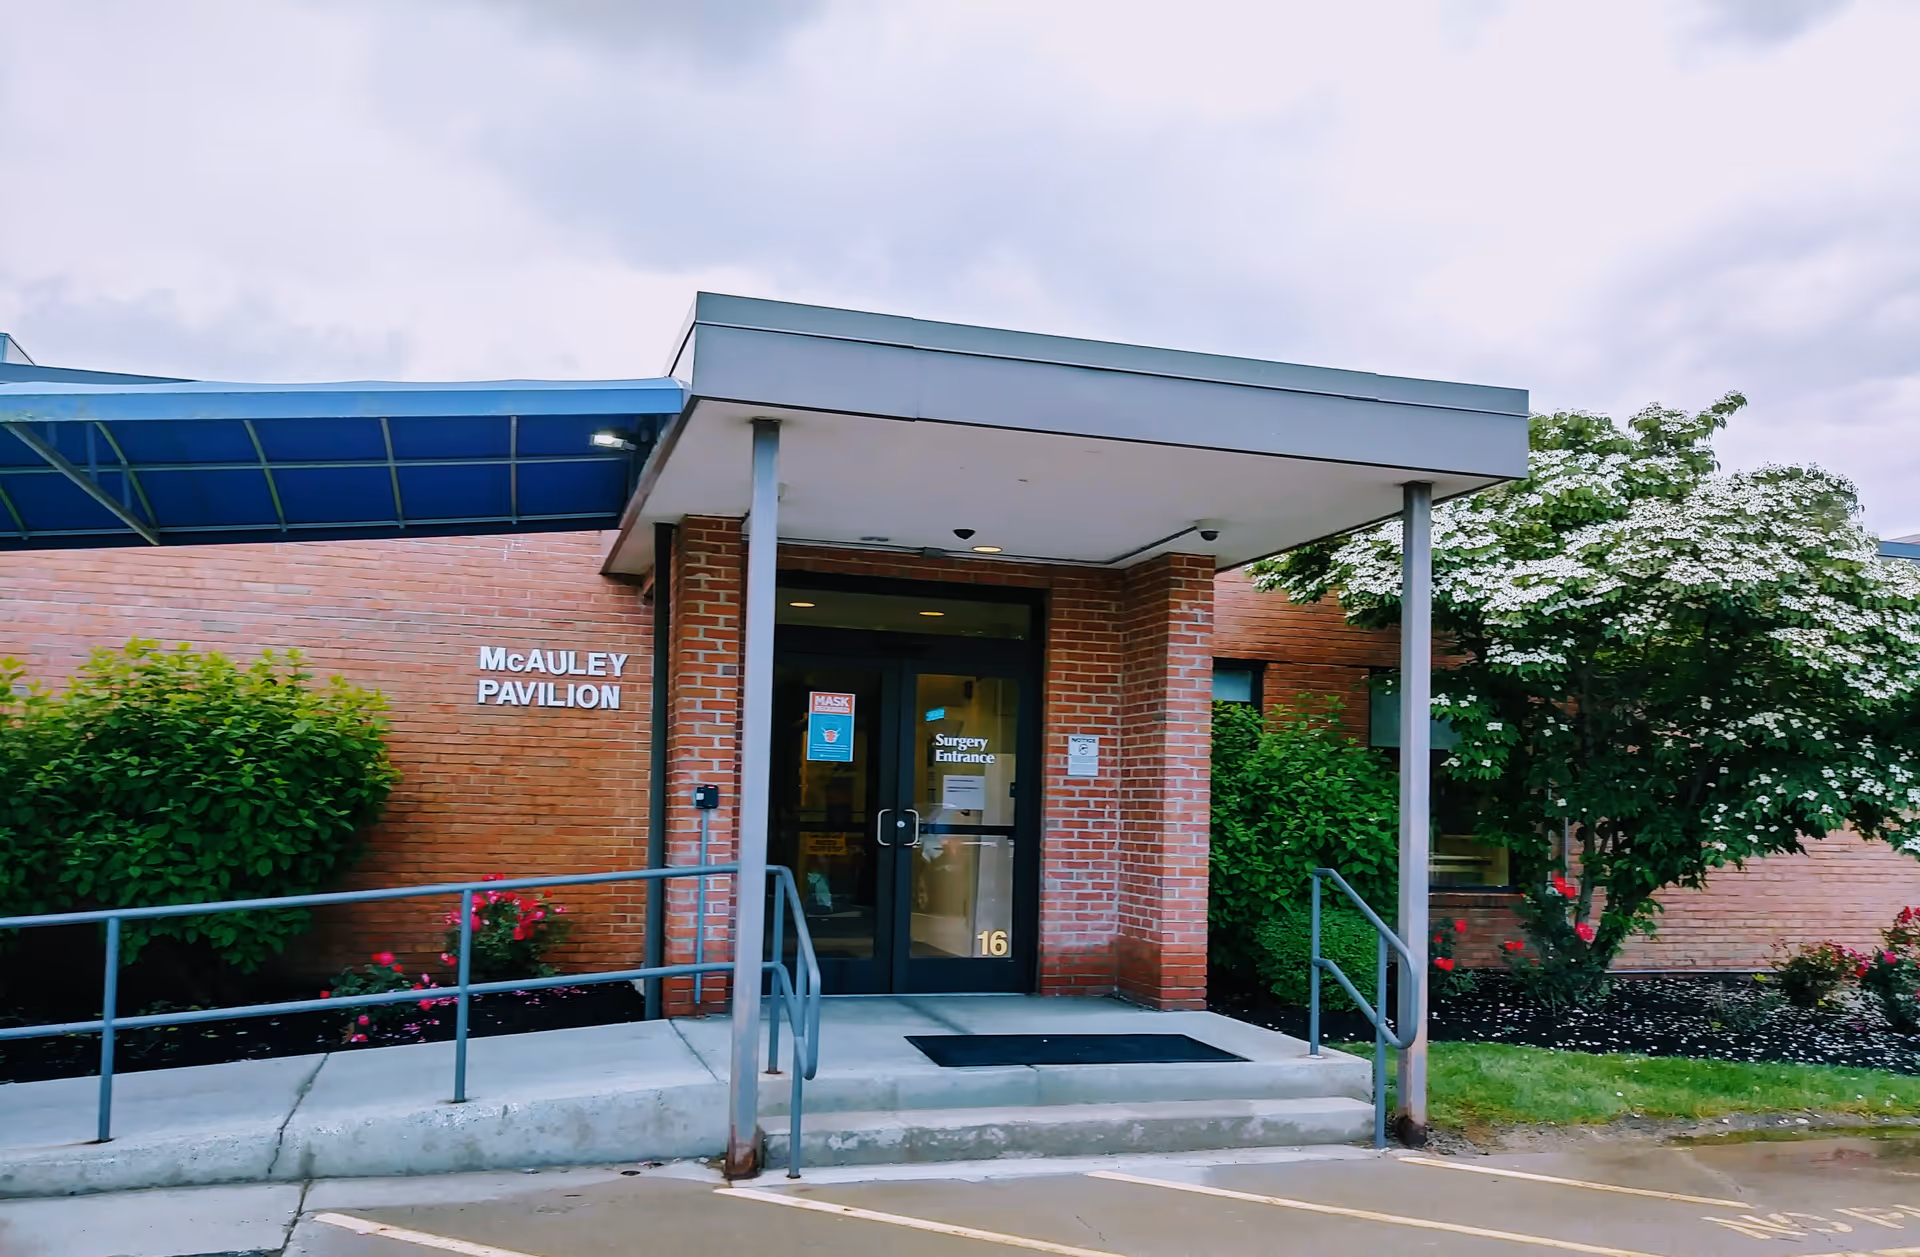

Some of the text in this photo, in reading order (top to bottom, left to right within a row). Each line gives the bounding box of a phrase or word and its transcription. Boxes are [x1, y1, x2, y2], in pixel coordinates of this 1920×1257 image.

[479, 646, 629, 677] McAULEY
[477, 679, 621, 710] PAVILION
[814, 695, 850, 707] MASK
[935, 733, 988, 752] Surgery
[935, 749, 996, 764] Entrance
[977, 930, 1008, 956] 16
